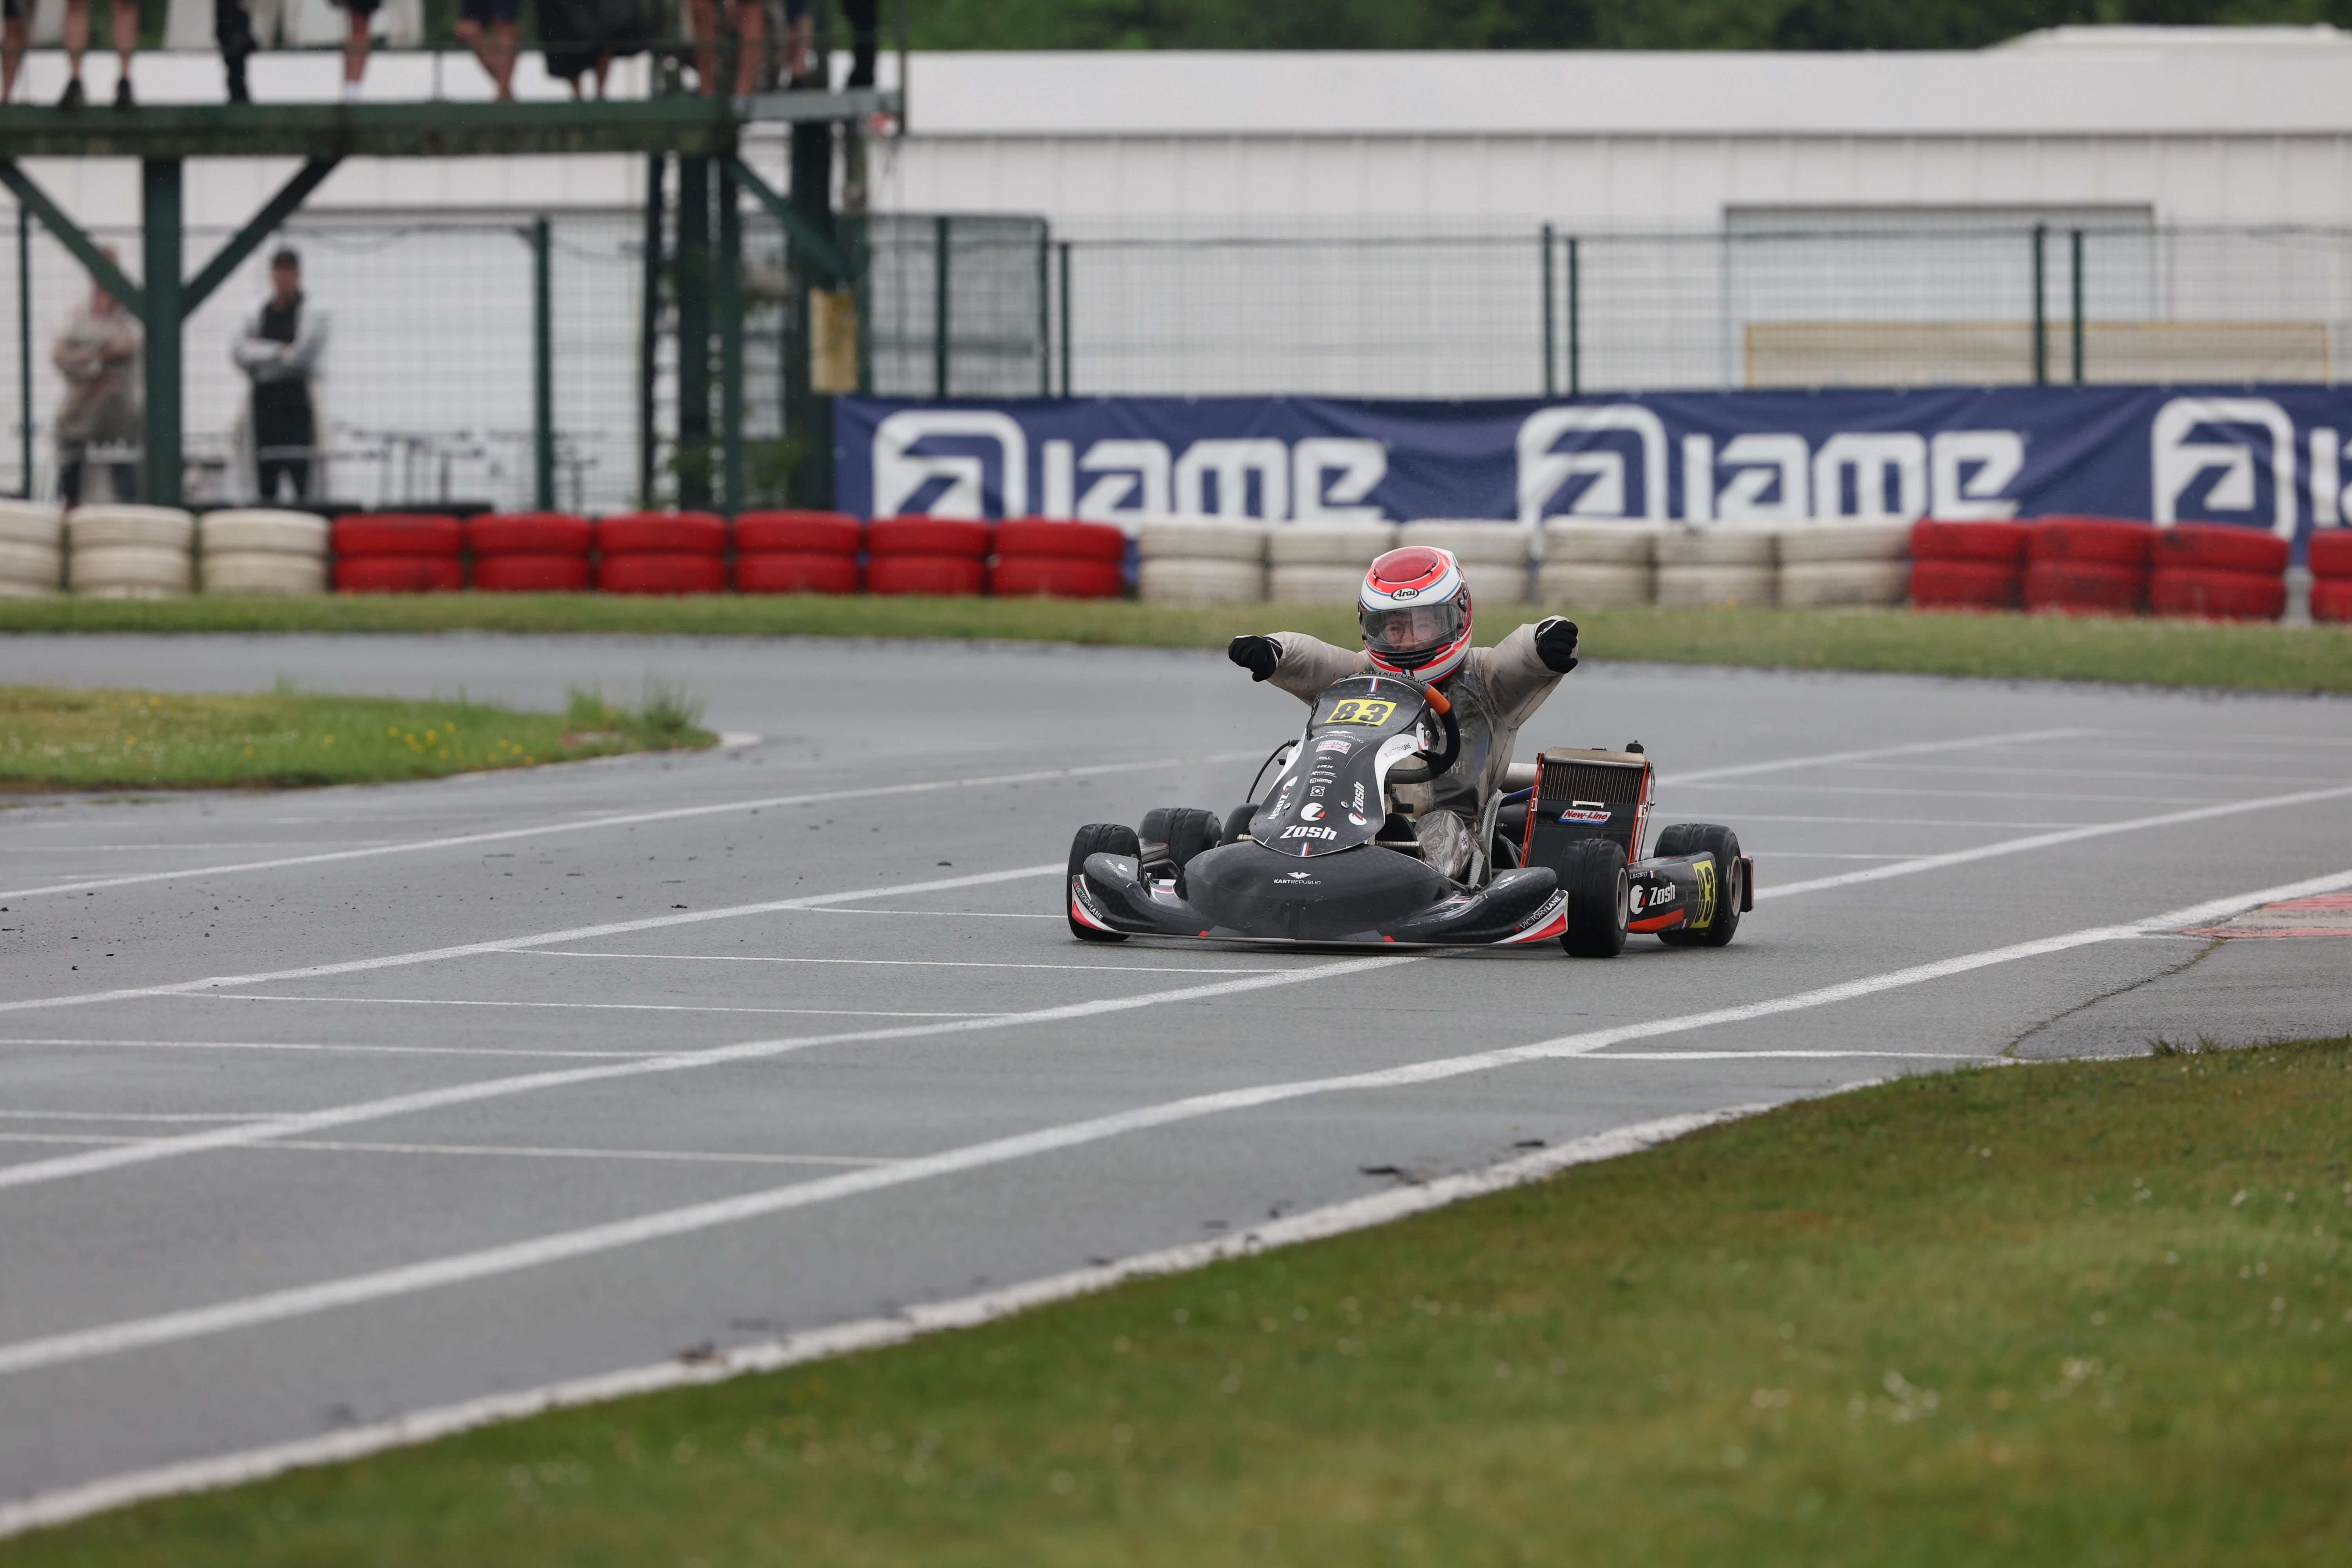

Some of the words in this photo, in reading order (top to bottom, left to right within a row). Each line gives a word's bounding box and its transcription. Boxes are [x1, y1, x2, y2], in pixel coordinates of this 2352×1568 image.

[1392, 589, 1416, 599] Arai
[1358, 671, 1426, 686] KARTREPUBLIC
[1331, 702, 1388, 722] 83
[1310, 734, 1364, 743] KARTREPUBLIC
[1353, 781, 1365, 813] Zosh
[1564, 810, 1608, 820] New-Line
[1279, 825, 1337, 840] Zosh
[1074, 881, 1103, 921] #VICTORYLANE
[1649, 882, 1675, 906] Zosh
[1694, 867, 1714, 923] 83
[1515, 895, 1562, 933] #VICTORYLANE
